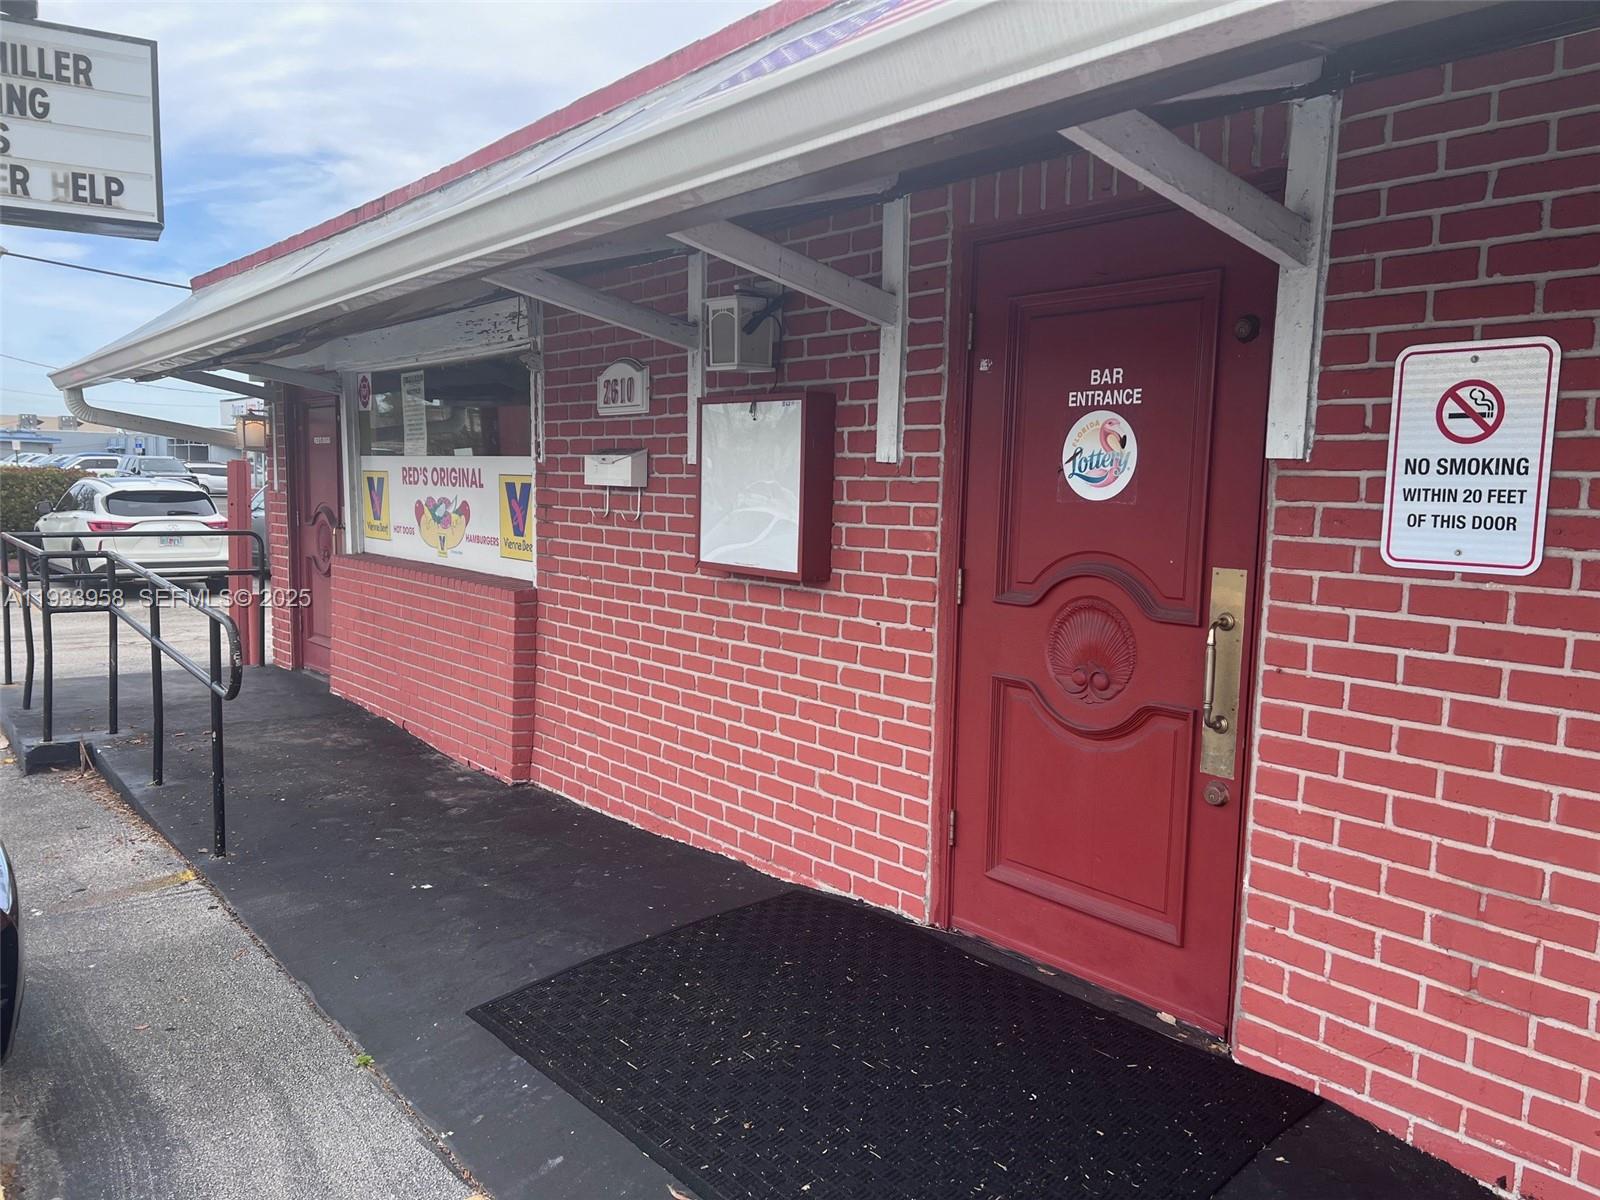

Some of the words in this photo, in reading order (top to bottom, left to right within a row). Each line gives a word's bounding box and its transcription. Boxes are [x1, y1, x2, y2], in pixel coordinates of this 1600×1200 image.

[51, 171, 125, 206] HELP
[1090, 367, 1124, 386] BAR
[603, 377, 635, 405] 2610
[1068, 388, 1142, 407] ENTRANCE
[1072, 419, 1101, 447] FLORIDA
[1066, 446, 1132, 479] Lottery
[1404, 458, 1430, 475] NO
[1436, 457, 1530, 476] SMOKING
[402, 466, 428, 486] RED'S
[431, 466, 484, 489] ORIGINAL
[1402, 487, 1458, 503] WITHIN
[1462, 489, 1482, 504] 20
[1487, 489, 1528, 505] FEET
[393, 525, 402, 534] HOT
[402, 526, 415, 536] DOGS
[1407, 513, 1427, 528] OF
[1431, 514, 1467, 530] THIS
[1472, 515, 1517, 531] DOOR
[465, 533, 500, 547] HAMBURGERS
[521, 539, 533, 552] Bee
